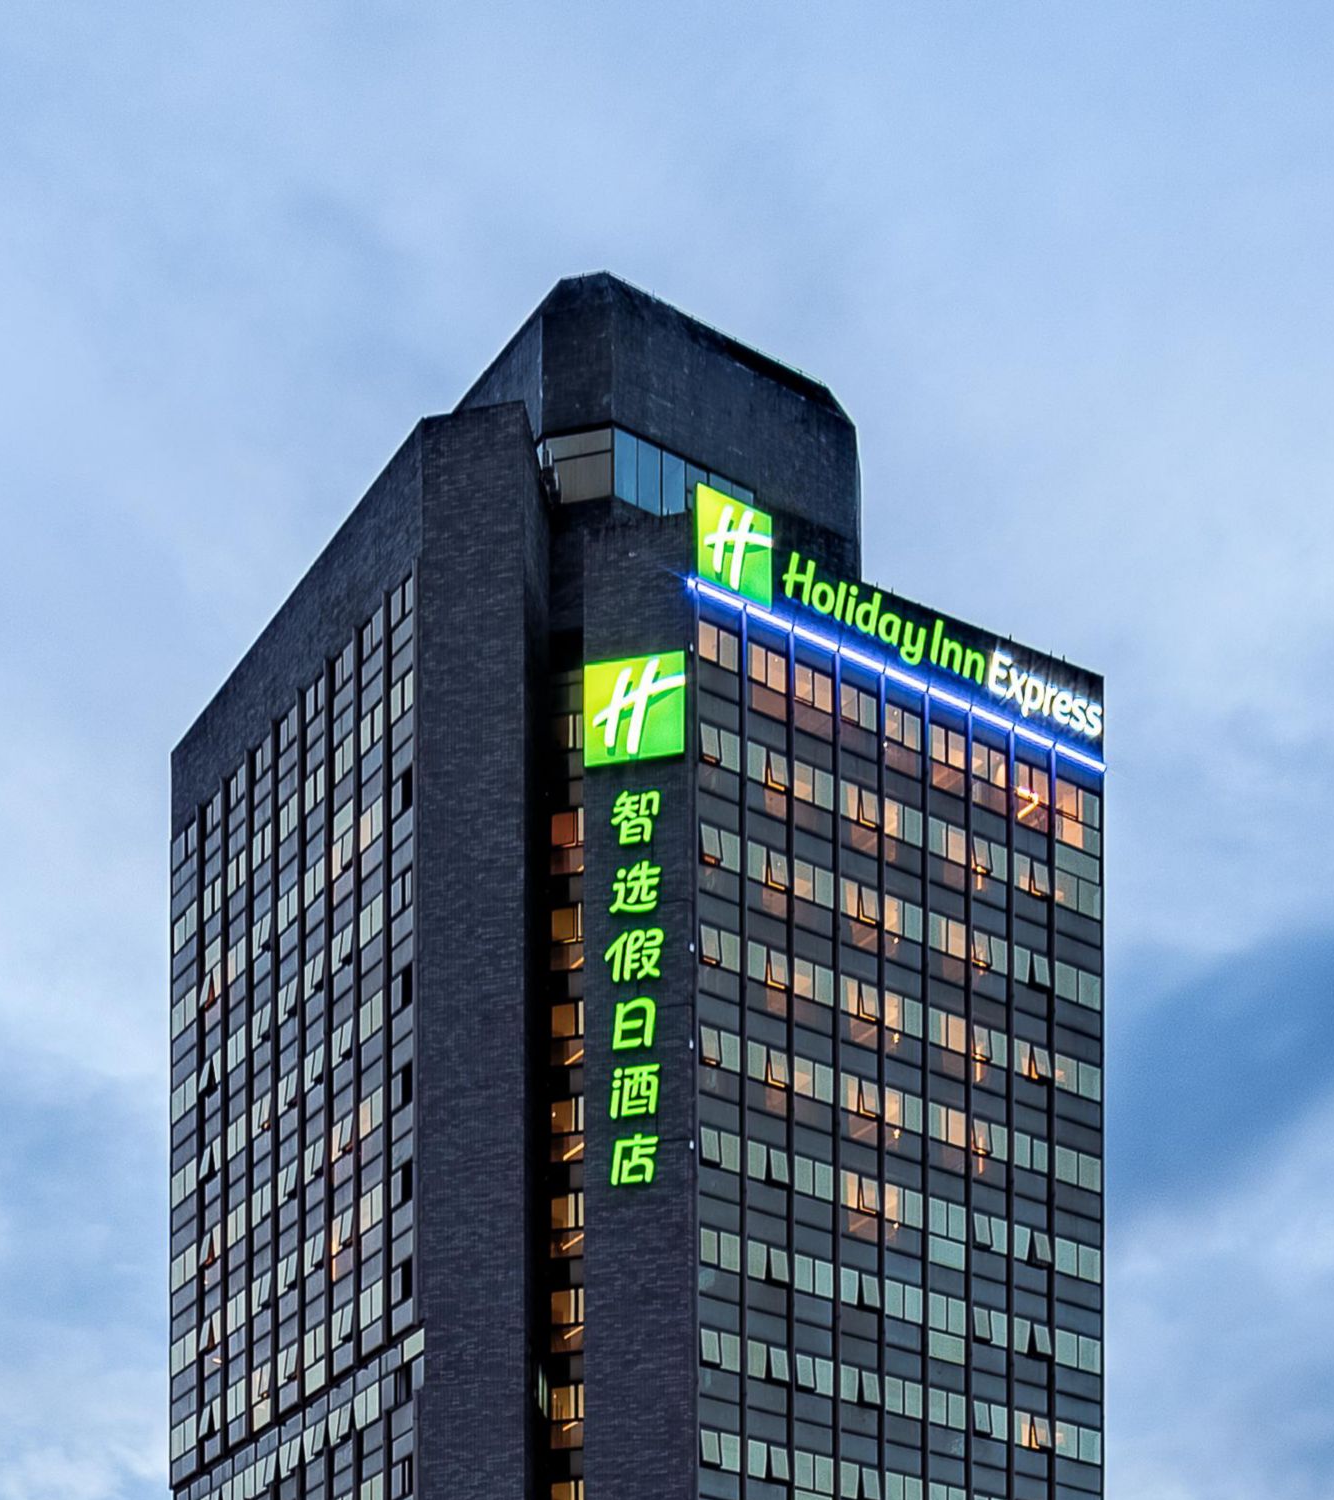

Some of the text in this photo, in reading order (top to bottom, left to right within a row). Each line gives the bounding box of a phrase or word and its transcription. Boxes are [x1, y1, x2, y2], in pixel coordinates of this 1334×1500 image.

[782, 551, 1103, 738] Holiday Inn Express
[604, 789, 665, 1186] 智选假日酒店
